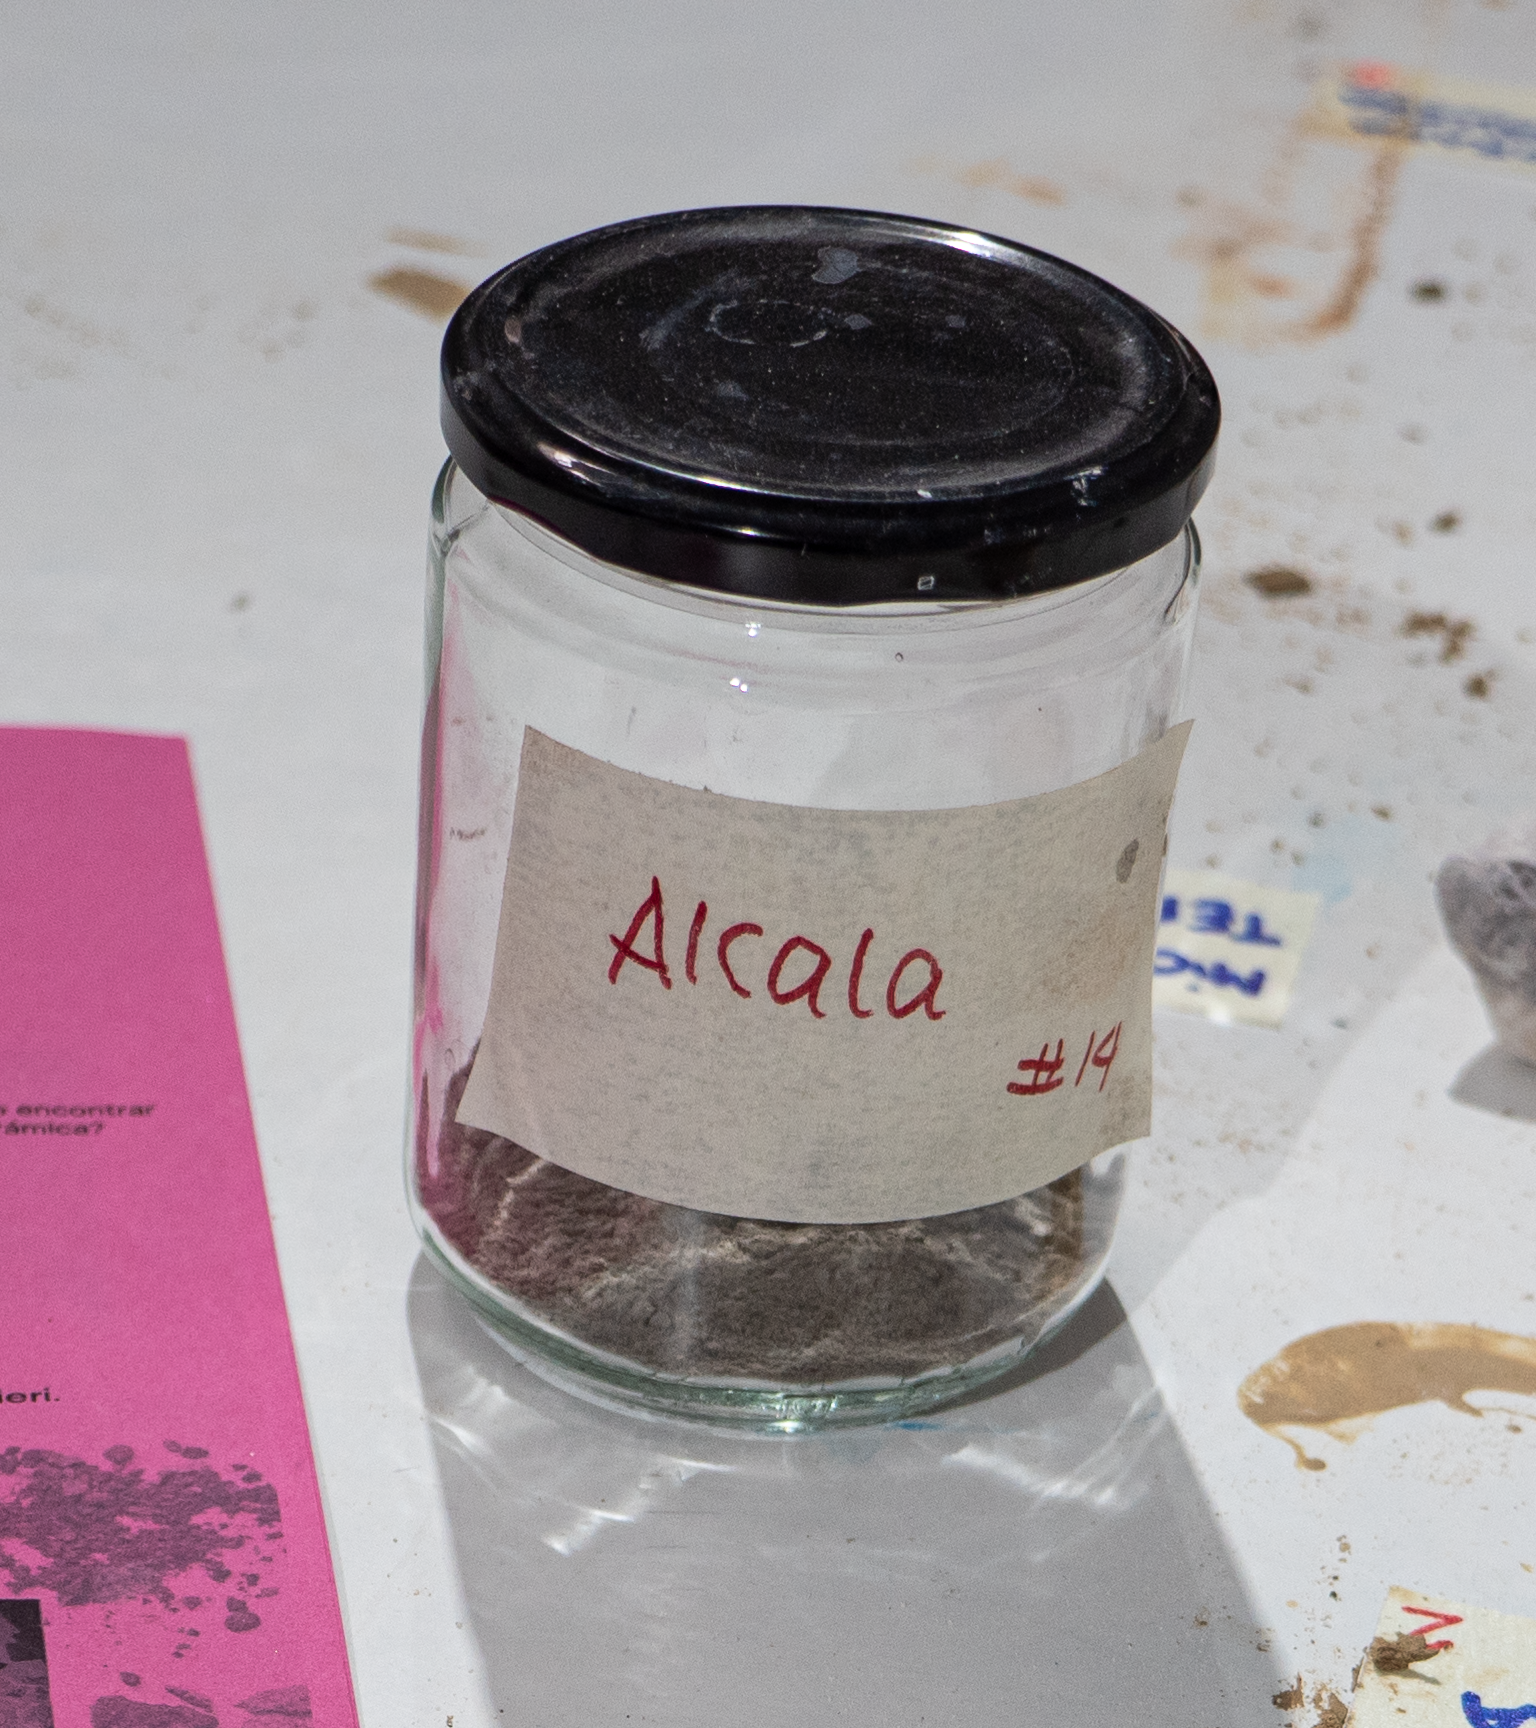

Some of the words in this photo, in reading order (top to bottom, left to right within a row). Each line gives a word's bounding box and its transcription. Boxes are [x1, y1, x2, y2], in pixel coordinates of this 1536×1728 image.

[607, 874, 947, 1022] Alcala
[1005, 1019, 1124, 1097] #14
[15, 1101, 156, 1118] encontrar
